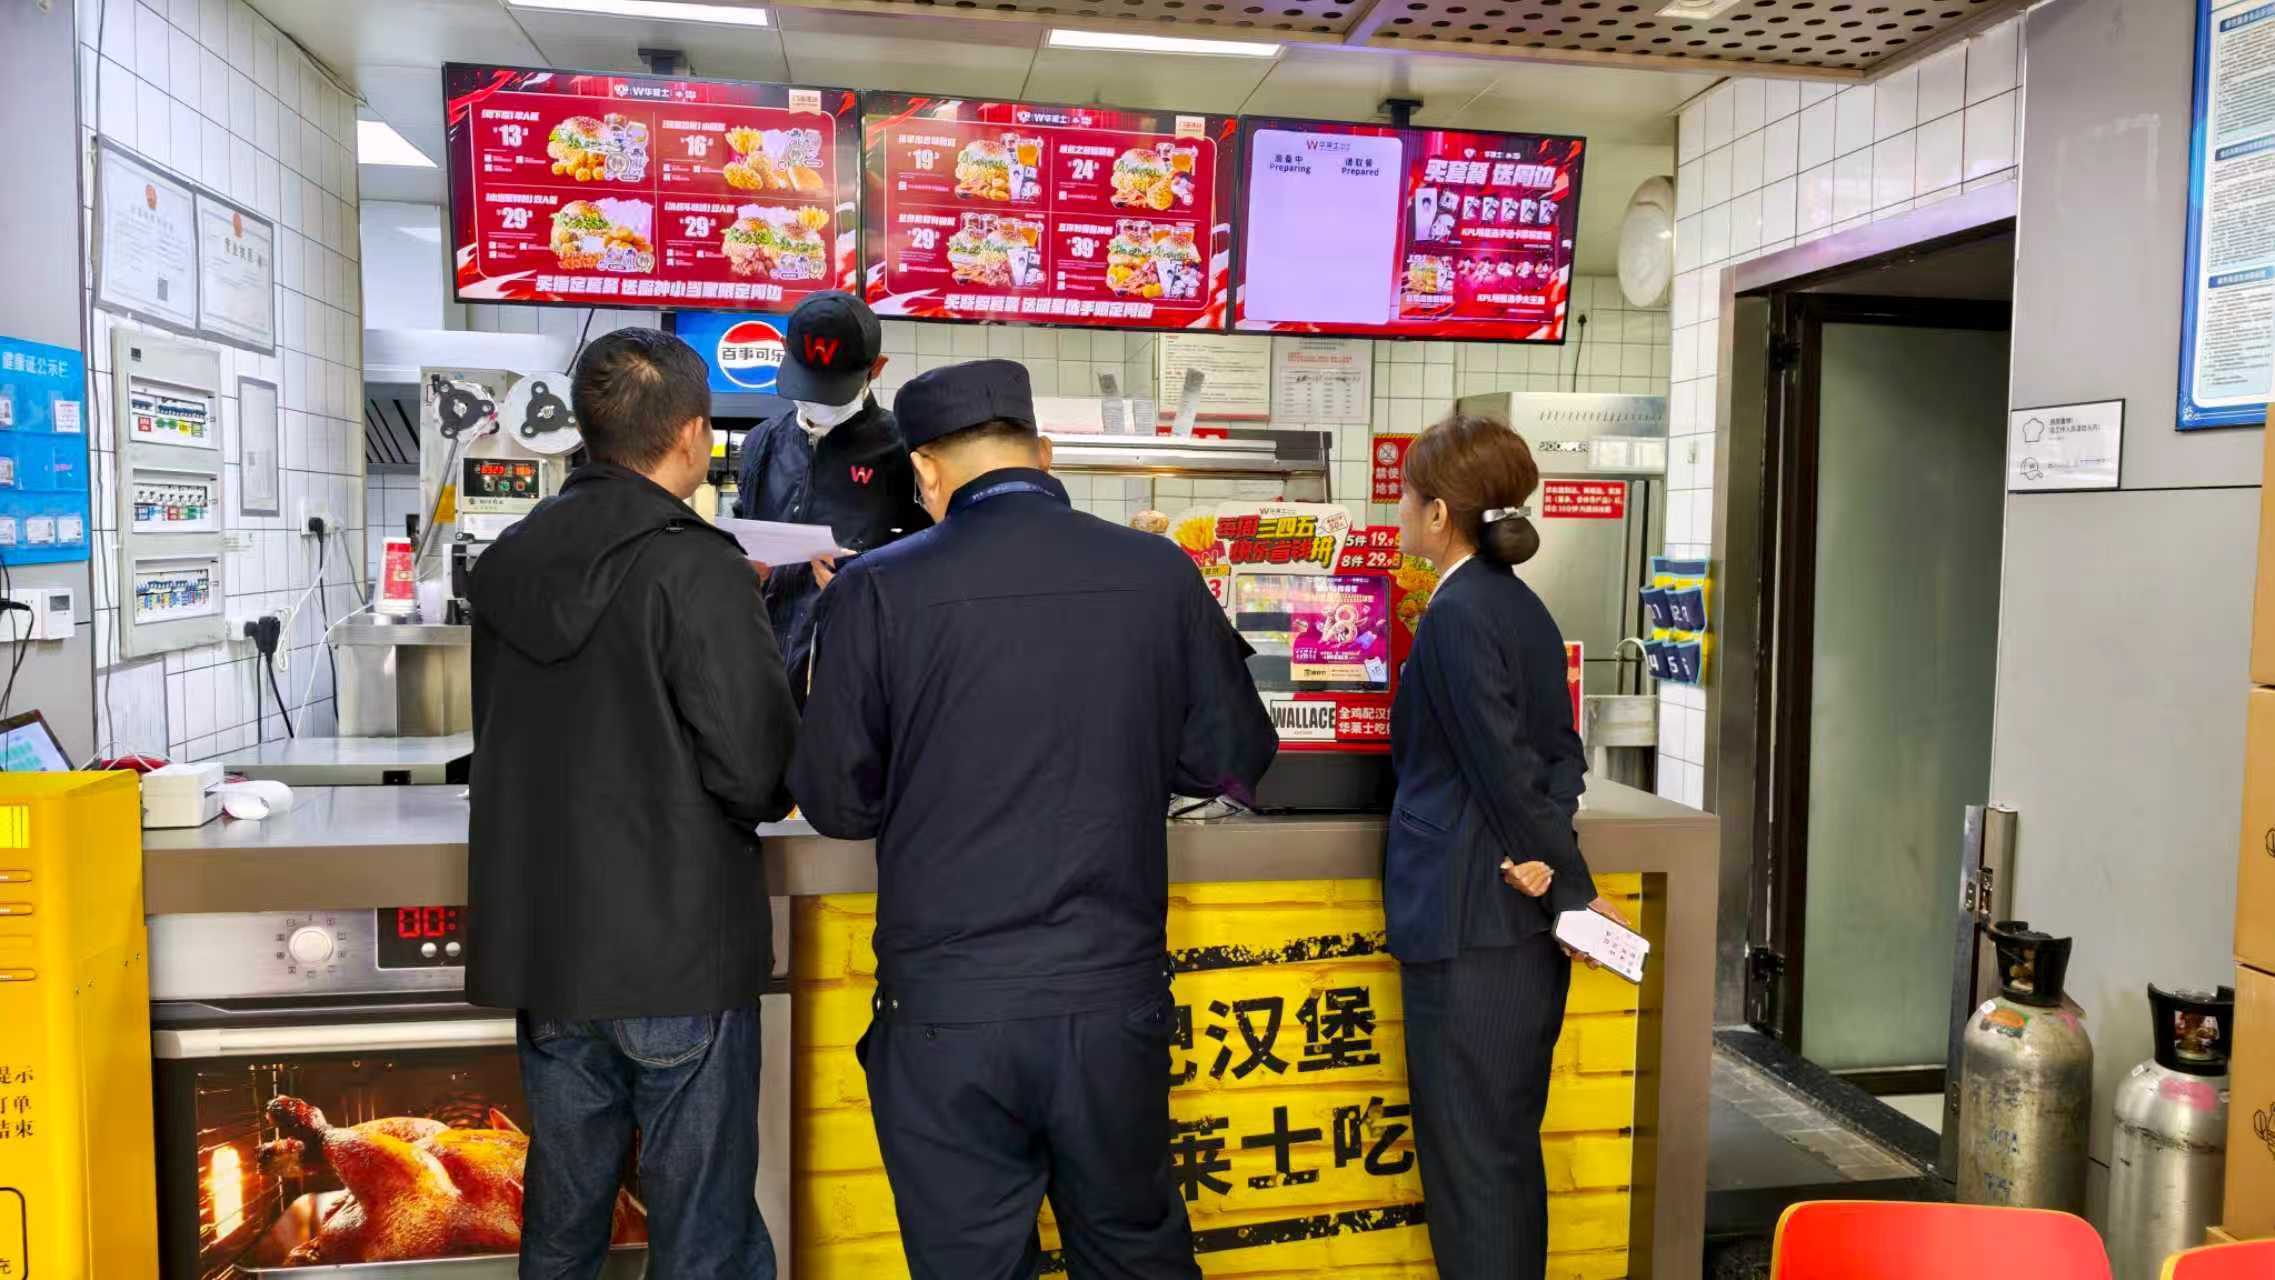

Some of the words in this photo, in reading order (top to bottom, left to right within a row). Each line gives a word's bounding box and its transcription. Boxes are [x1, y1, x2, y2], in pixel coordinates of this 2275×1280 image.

[1270, 163, 1311, 174] Preparing
[1342, 168, 1379, 177] Prepared
[1424, 159, 1489, 184] 买套餐
[1491, 163, 1557, 188] 送周边
[722, 347, 786, 362] 百事可乐
[803, 331, 841, 367] W
[850, 465, 873, 485] W
[1215, 514, 1318, 539] 每周三四五
[1346, 534, 1368, 547] 5件
[1230, 535, 1337, 569] 快乐省钱拼
[1340, 555, 1364, 568] 8件
[1271, 706, 1336, 730] WALLACE
[1338, 706, 1391, 720] 全鸡配汉
[1338, 721, 1391, 736] 华莱士吃
[1168, 1096, 1416, 1201] 莱士吃
